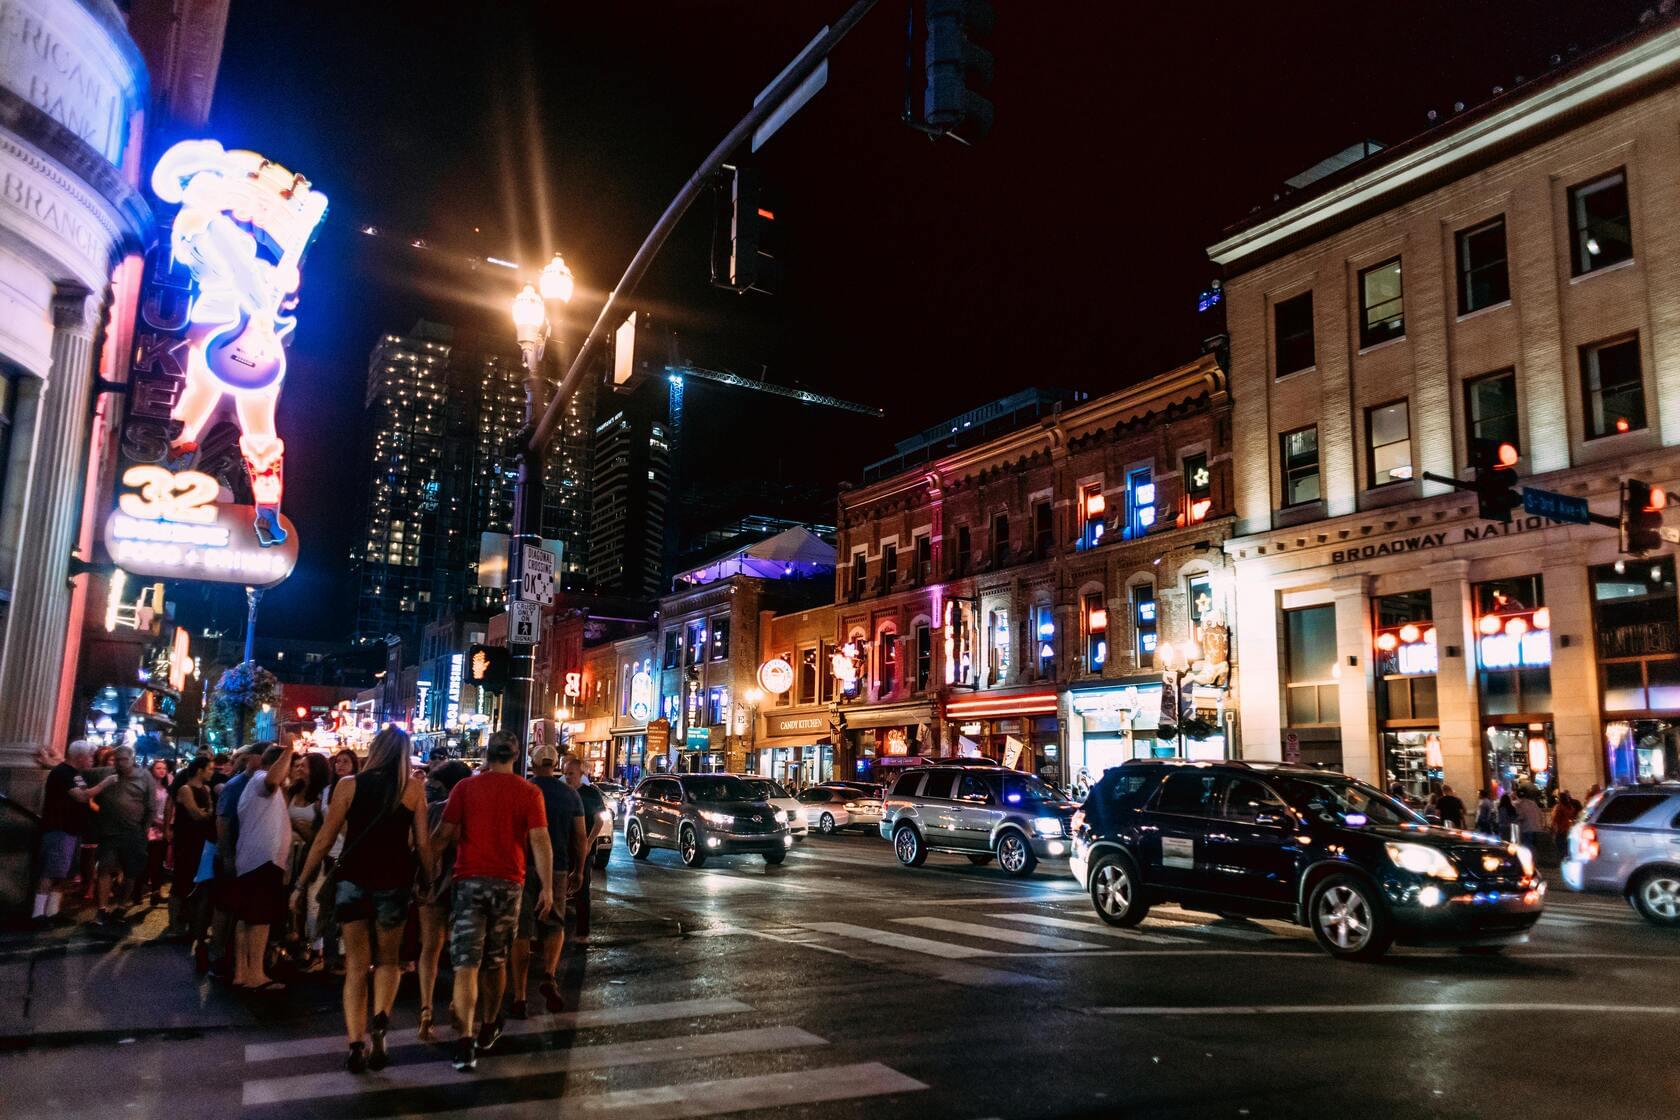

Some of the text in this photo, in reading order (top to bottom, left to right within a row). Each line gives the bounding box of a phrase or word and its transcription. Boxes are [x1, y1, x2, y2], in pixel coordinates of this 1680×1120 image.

[29, 75, 97, 140] BANK
[3, 173, 98, 262] BRANCH
[119, 464, 219, 523] 32
[528, 547, 552, 564] DIAGONAL
[1332, 532, 1448, 563] BROADWAY
[528, 559, 552, 574] CROSSING
[524, 573, 537, 594] OK
[516, 603, 536, 611] CROSS
[780, 718, 823, 730] CANDY KITCHEN
